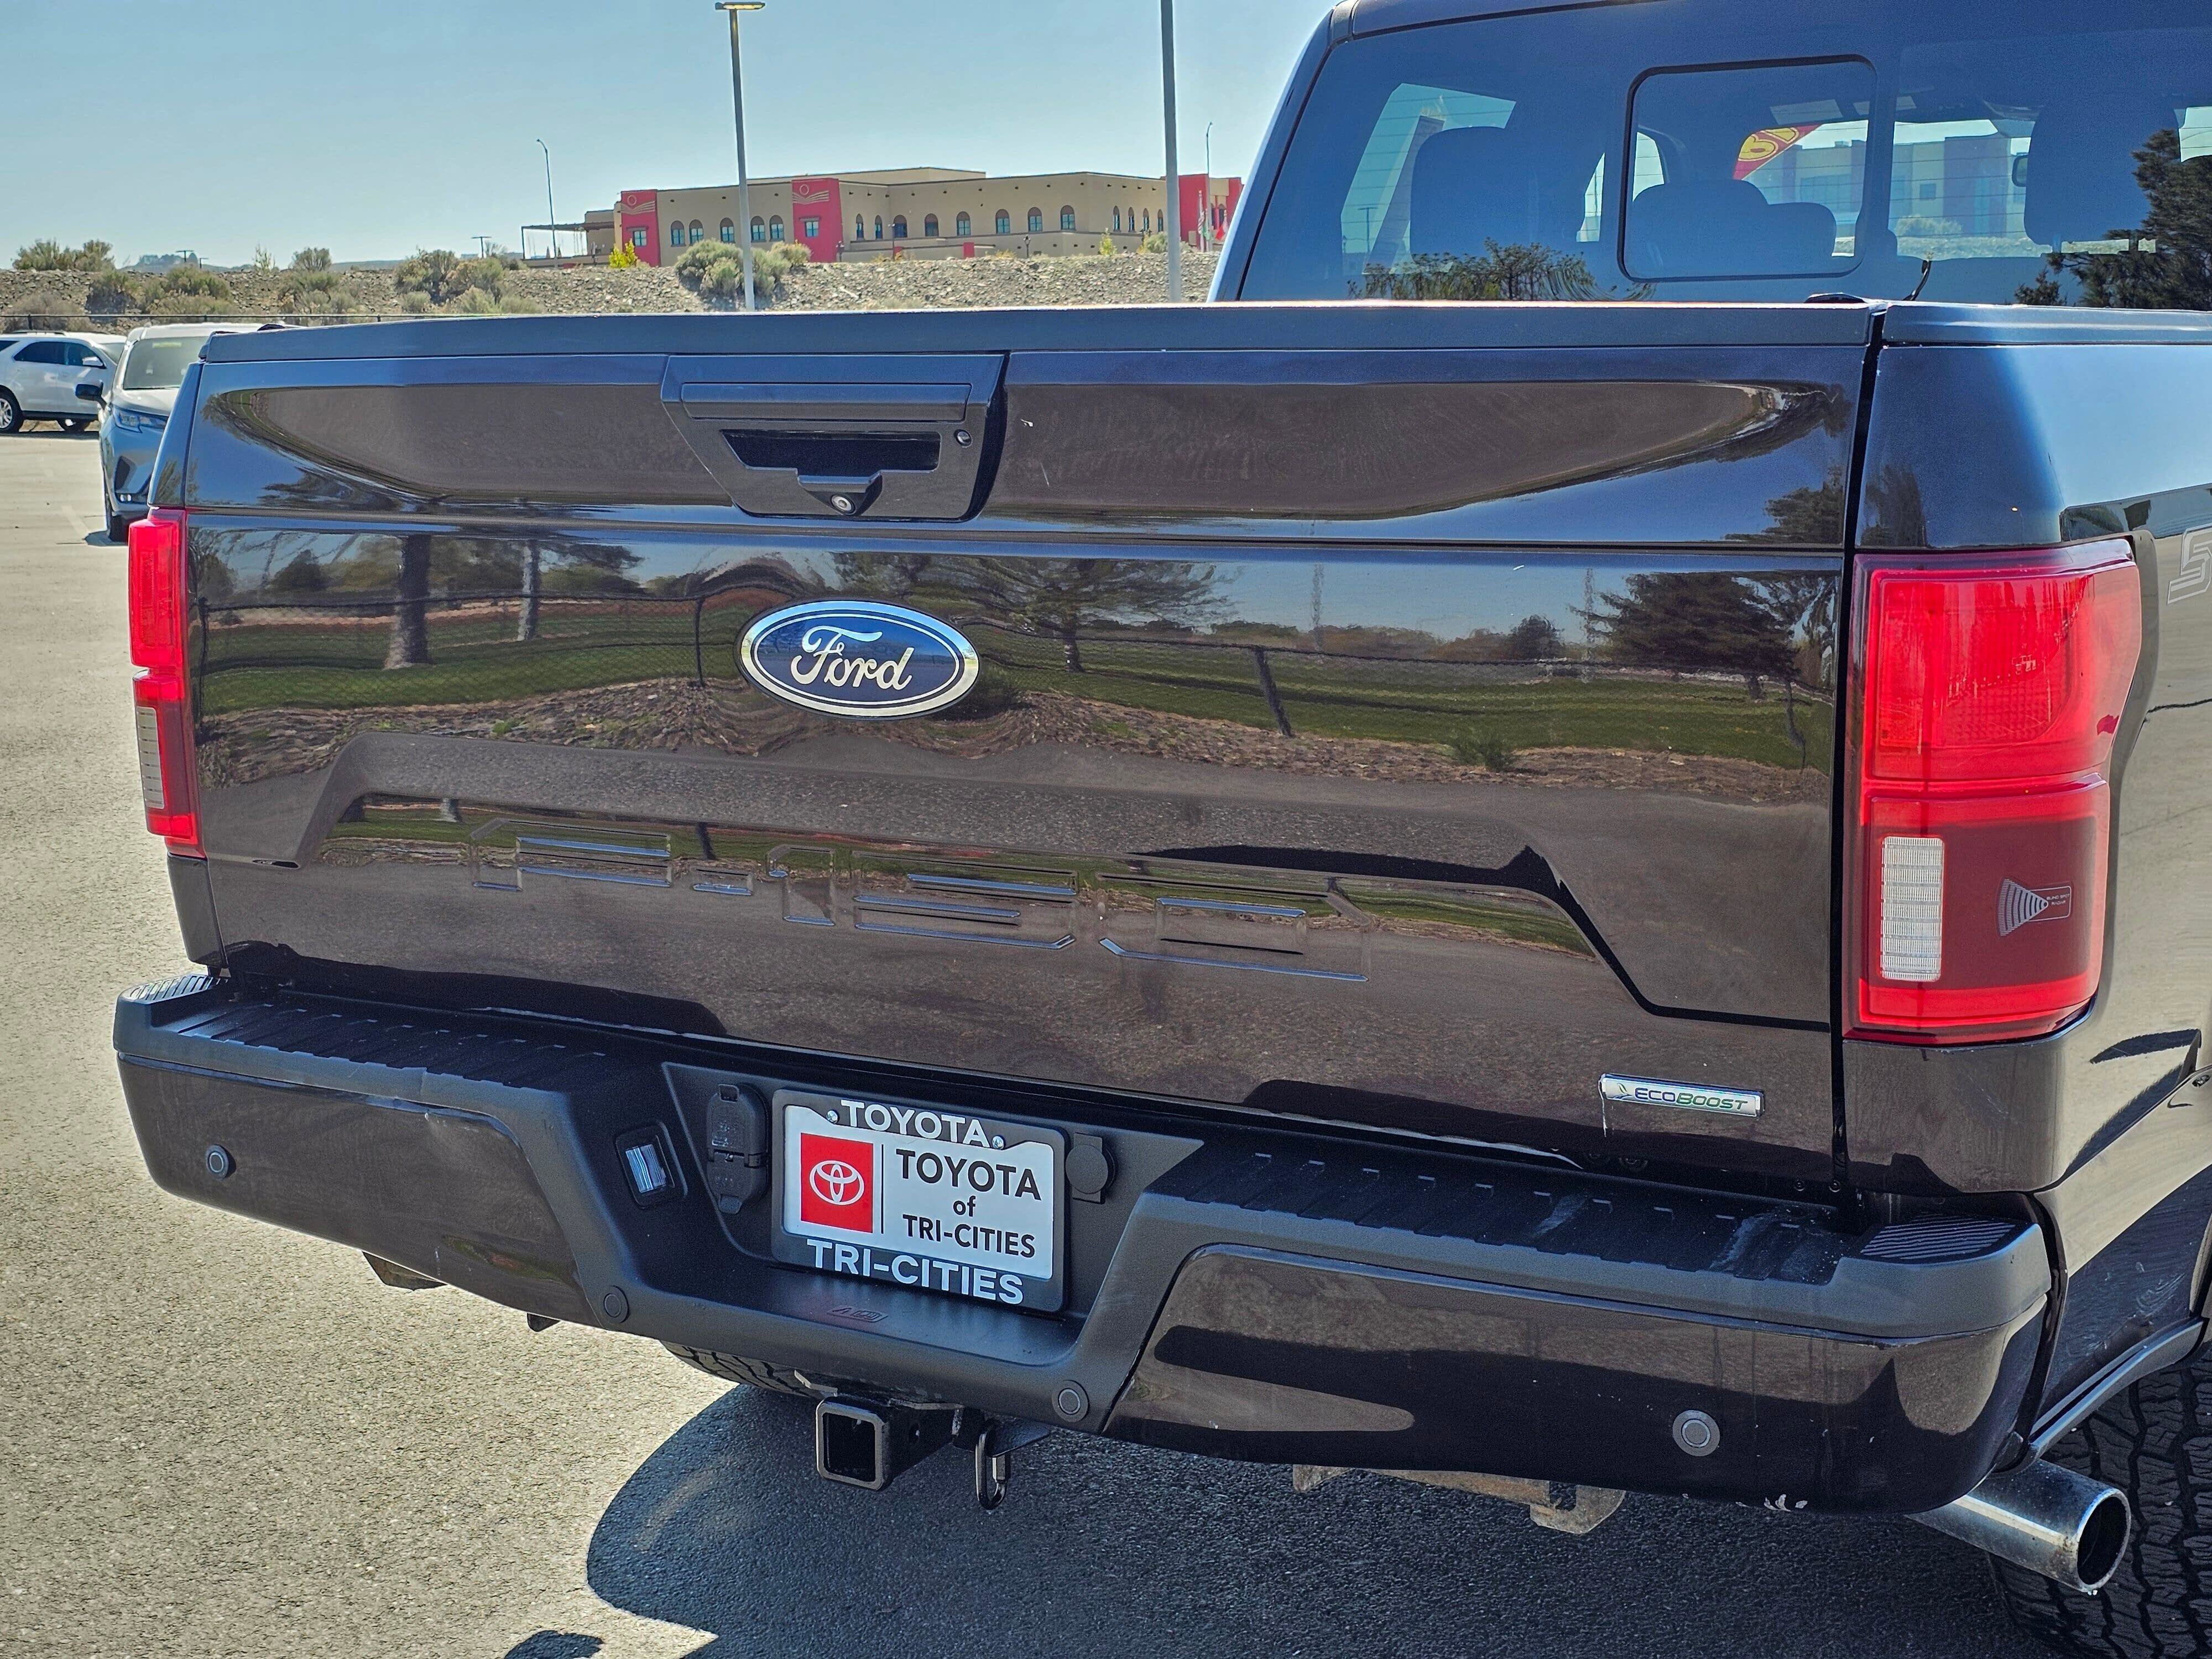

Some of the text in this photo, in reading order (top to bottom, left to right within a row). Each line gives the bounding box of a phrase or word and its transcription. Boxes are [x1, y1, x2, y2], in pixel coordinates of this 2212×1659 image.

[791, 625, 914, 690] Ford
[841, 1099, 989, 1149] TOYOTA
[895, 1149, 1042, 1201] TOYOTA
[953, 1196, 976, 1217] of
[902, 1214, 1035, 1259] TRI-CITIES
[807, 1239, 1025, 1305] TRI-CITIES
